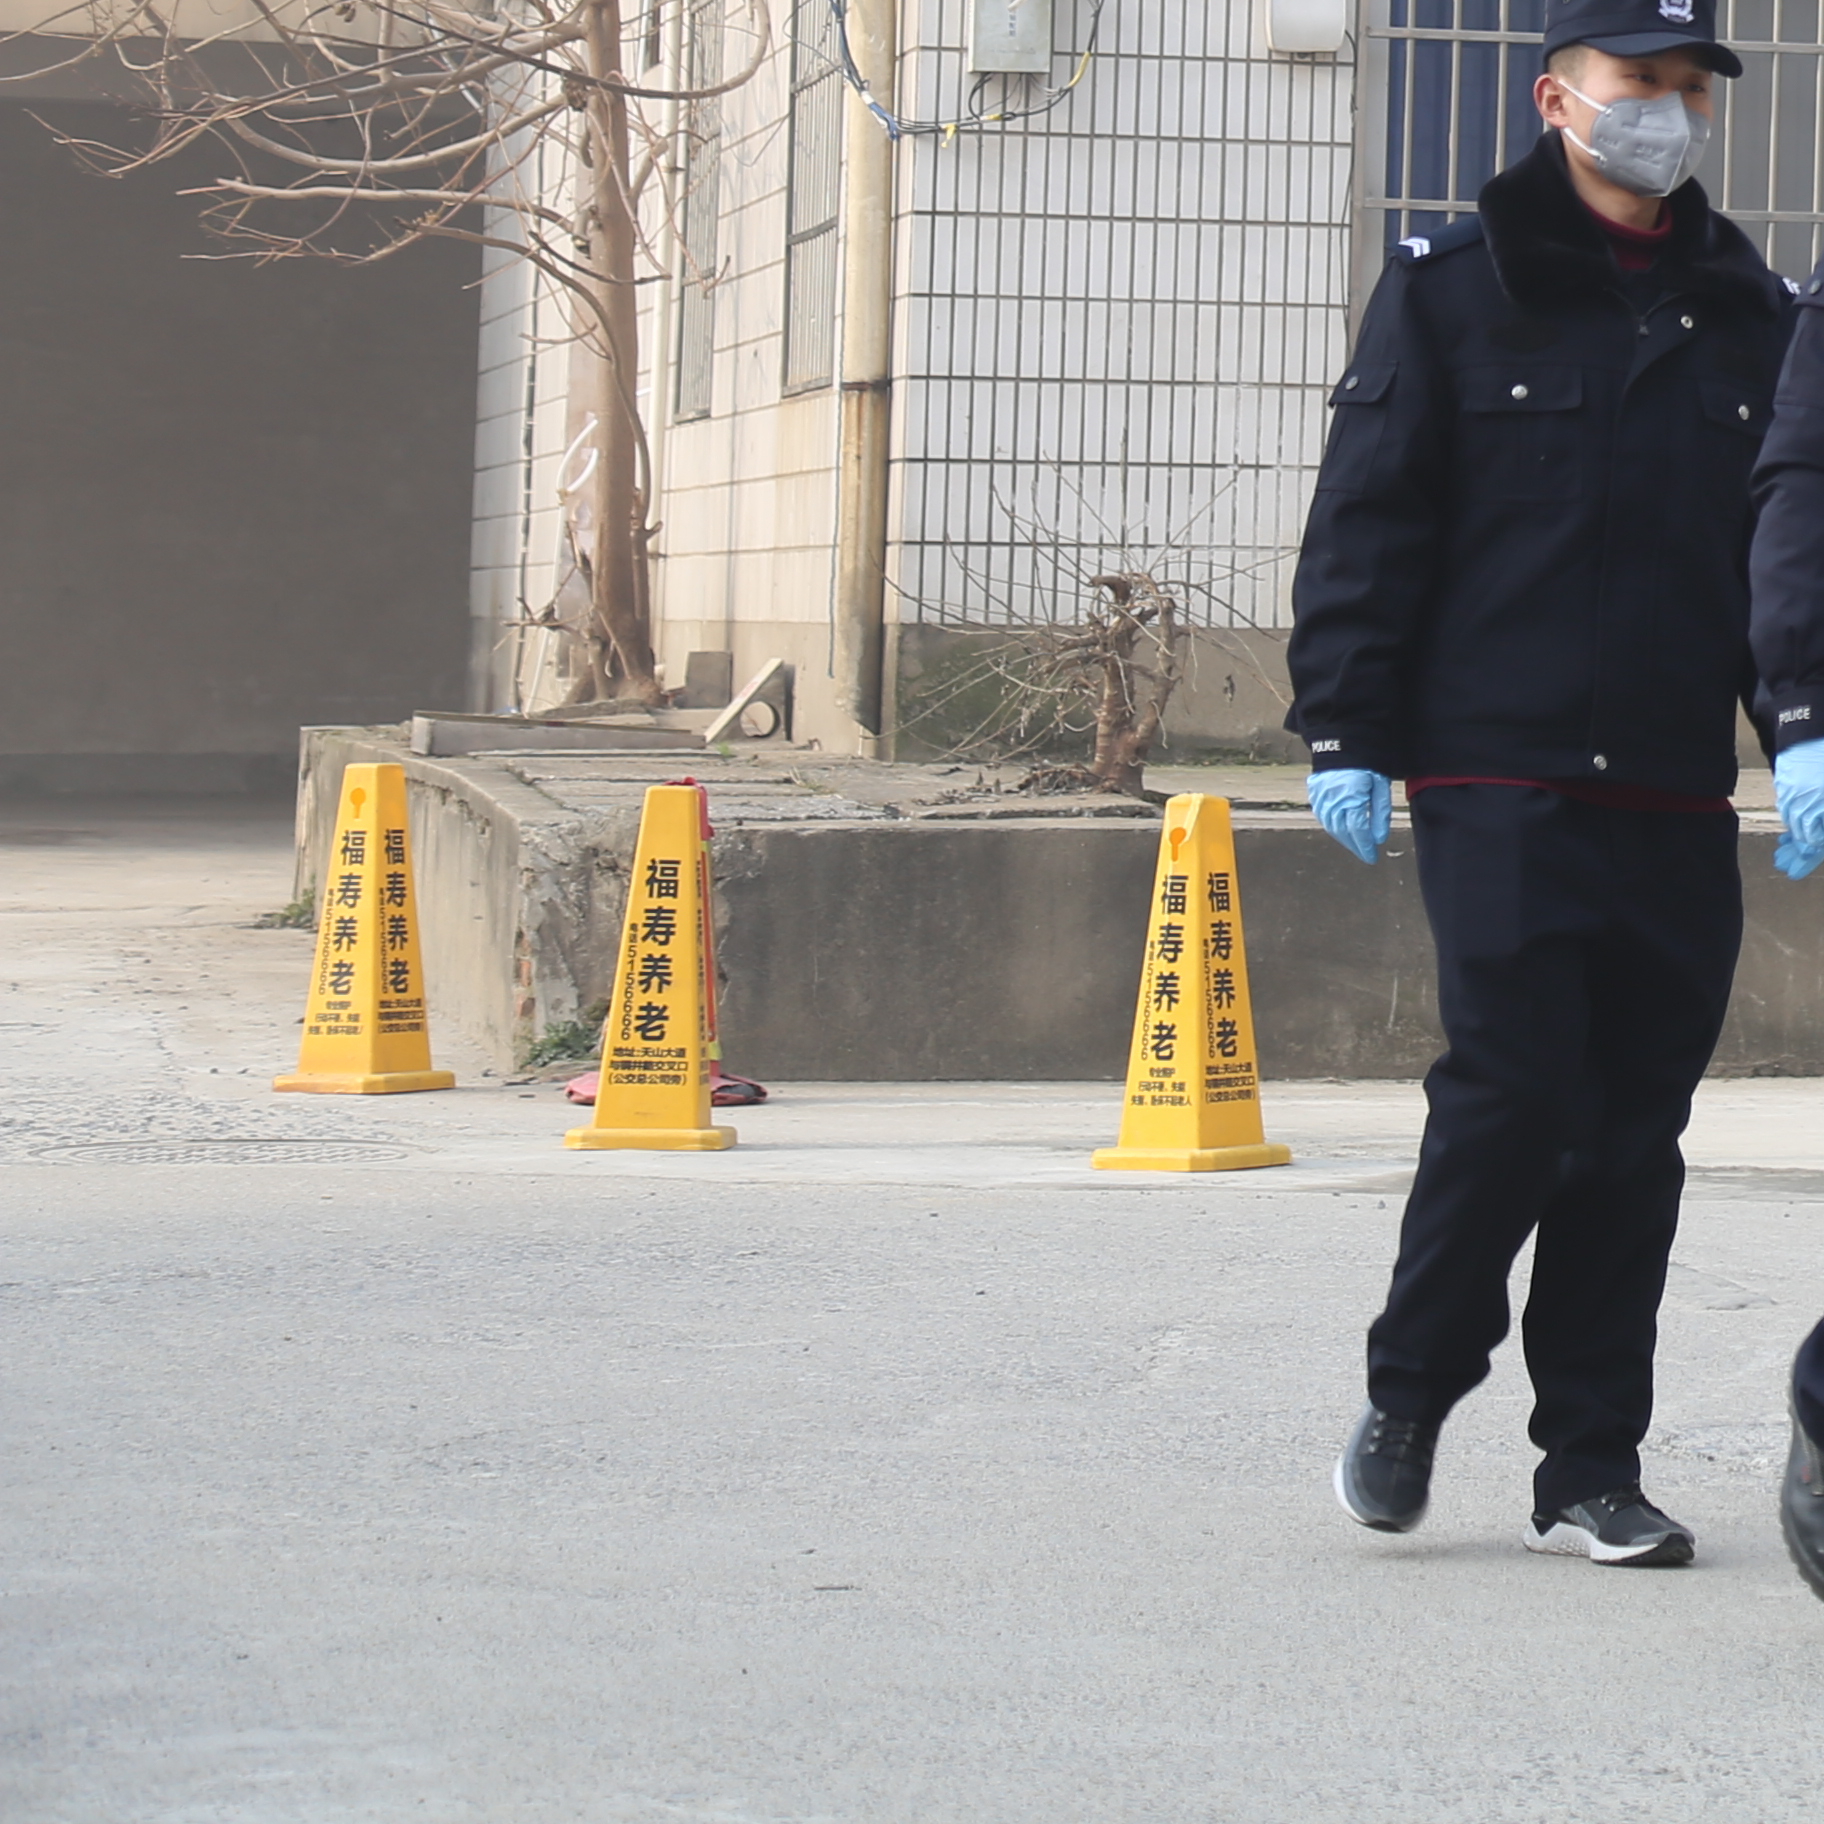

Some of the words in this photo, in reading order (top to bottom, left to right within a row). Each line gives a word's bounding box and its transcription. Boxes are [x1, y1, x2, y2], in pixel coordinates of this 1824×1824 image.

[1312, 740, 1341, 753] POLICE
[1779, 707, 1810, 726] POLICE
[328, 829, 367, 996] 福寿养老
[384, 828, 409, 994] 福寿养老
[634, 858, 681, 1042] 福寿养老
[1150, 874, 1189, 1062] 福寿养老
[1207, 872, 1238, 1058] 福寿养老
